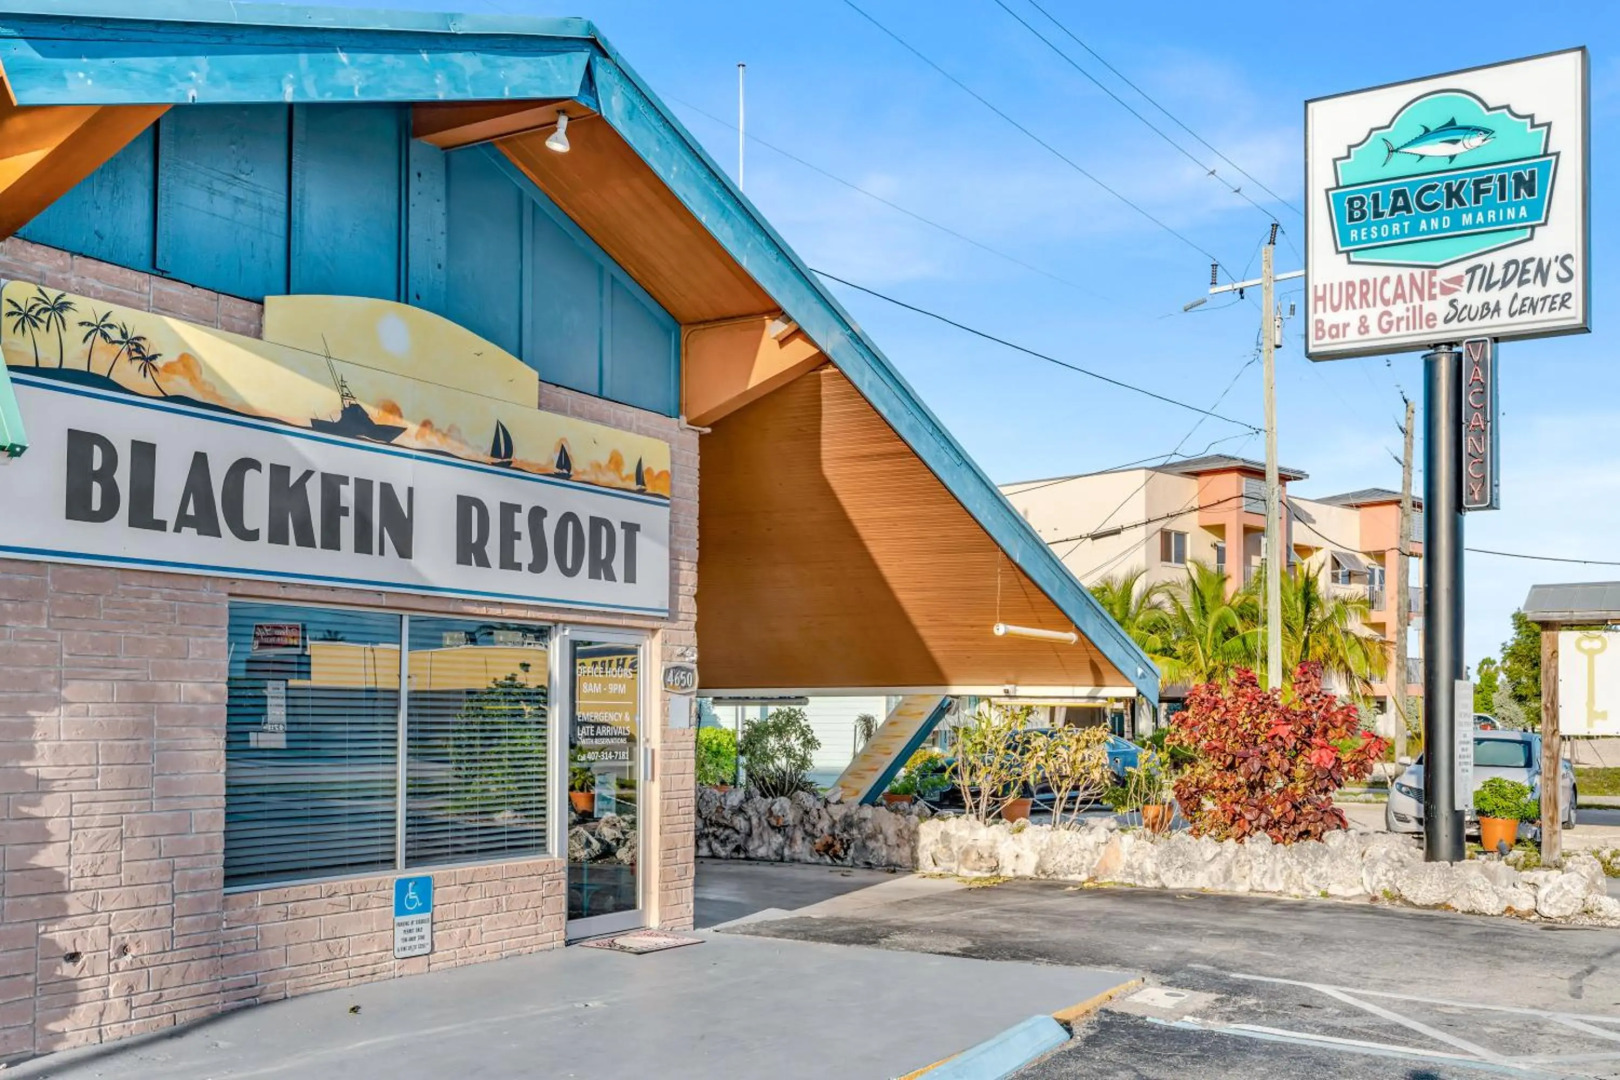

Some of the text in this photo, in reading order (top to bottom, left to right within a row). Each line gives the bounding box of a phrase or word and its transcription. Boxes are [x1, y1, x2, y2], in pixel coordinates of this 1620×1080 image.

[1345, 169, 1538, 224] BLACKFIN
[1350, 205, 1528, 242] RESORT AND MARINA
[1313, 269, 1438, 315] HURRICANE
[1465, 253, 1575, 294] TILDEN'S
[1314, 304, 1438, 341] Bar & Grille
[1467, 342, 1485, 502] VACANCY
[64, 428, 641, 584] BLACKFIN RESORT
[577, 665, 633, 679] OFFICE HOURS
[582, 682, 602, 694] 8AM
[608, 683, 626, 695] 9PM
[666, 670, 693, 687] 4650
[577, 711, 630, 722] EMERGENCY &
[577, 725, 630, 736] LATE ARRIVALS
